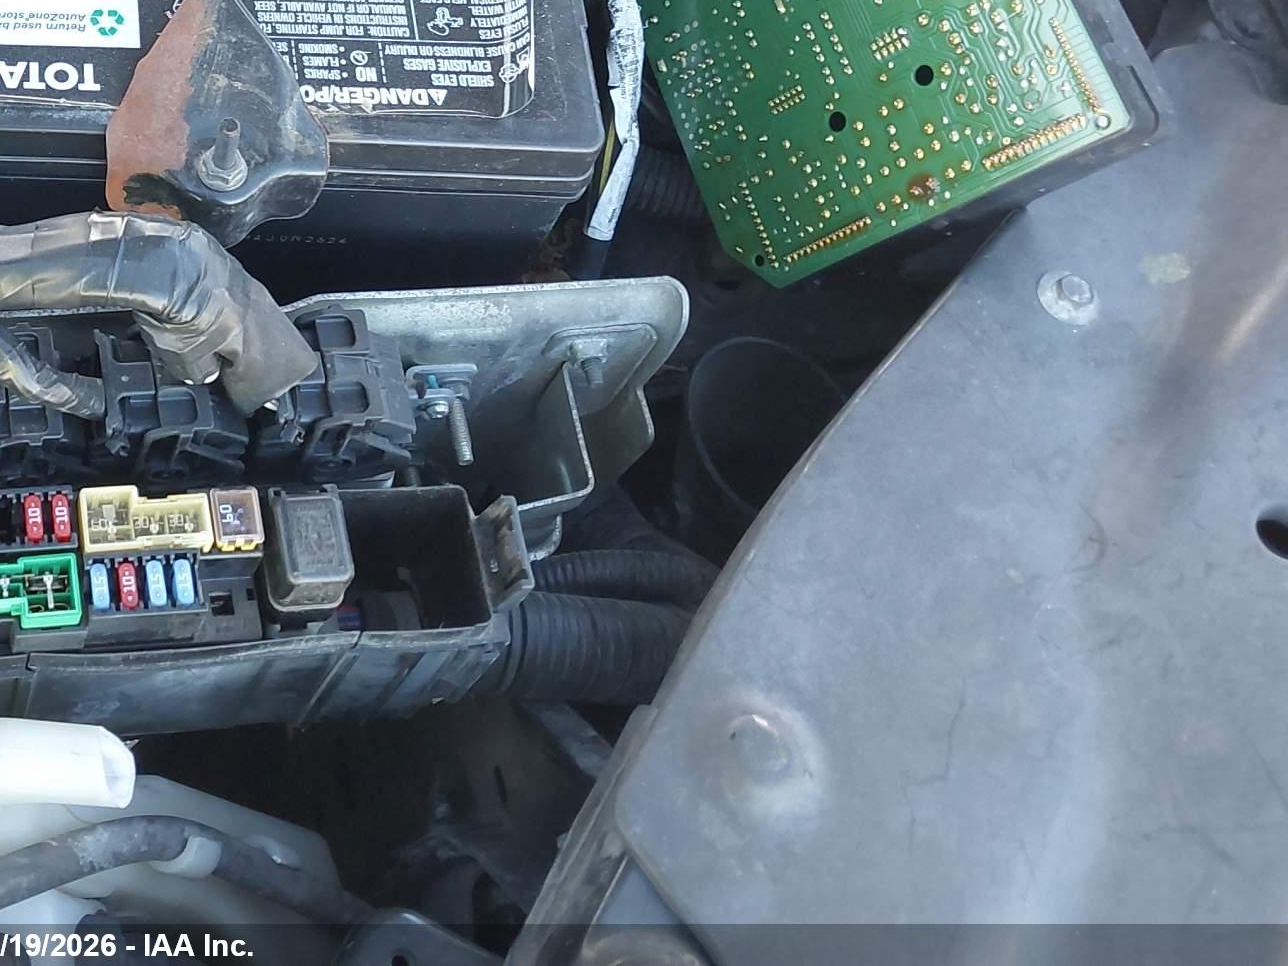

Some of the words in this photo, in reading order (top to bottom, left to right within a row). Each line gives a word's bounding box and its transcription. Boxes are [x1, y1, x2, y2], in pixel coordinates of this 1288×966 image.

[253, 0, 276, 11] SEEK
[276, 0, 326, 12] AVAILABLE,
[326, 2, 345, 13] NOT
[346, 3, 355, 13] IF
[368, 3, 406, 14] MANUAL
[257, 11, 295, 22] OWNERS
[296, 12, 333, 24] VEHICLE
[333, 13, 343, 24] IN
[344, 13, 408, 25] INSTRUCTIONS
[14, 21, 42, 31] used
[46, 22, 86, 32] Return
[320, 24, 344, 35] JUMP
[346, 25, 364, 35] FOR
[367, 25, 410, 37] CAUTION:
[478, 28, 502, 40] EYES
[298, 43, 339, 54] SMOKING
[384, 44, 418, 56] INJURY
[418, 45, 433, 56] OR
[432, 45, 485, 57] BLINDNESS
[302, 56, 340, 67] FLAMES
[403, 58, 436, 71] GASES
[437, 59, 492, 72] EXPLOSIVE
[304, 68, 341, 80] SPARKS
[354, 66, 377, 82] NO
[430, 73, 457, 86] EYES
[459, 74, 495, 87] SHIELD
[299, 85, 428, 105] DANGER/PO
[28, 507, 41, 524] 10
[55, 506, 69, 523] 10
[219, 504, 234, 523] 60
[122, 576, 136, 593] 10
